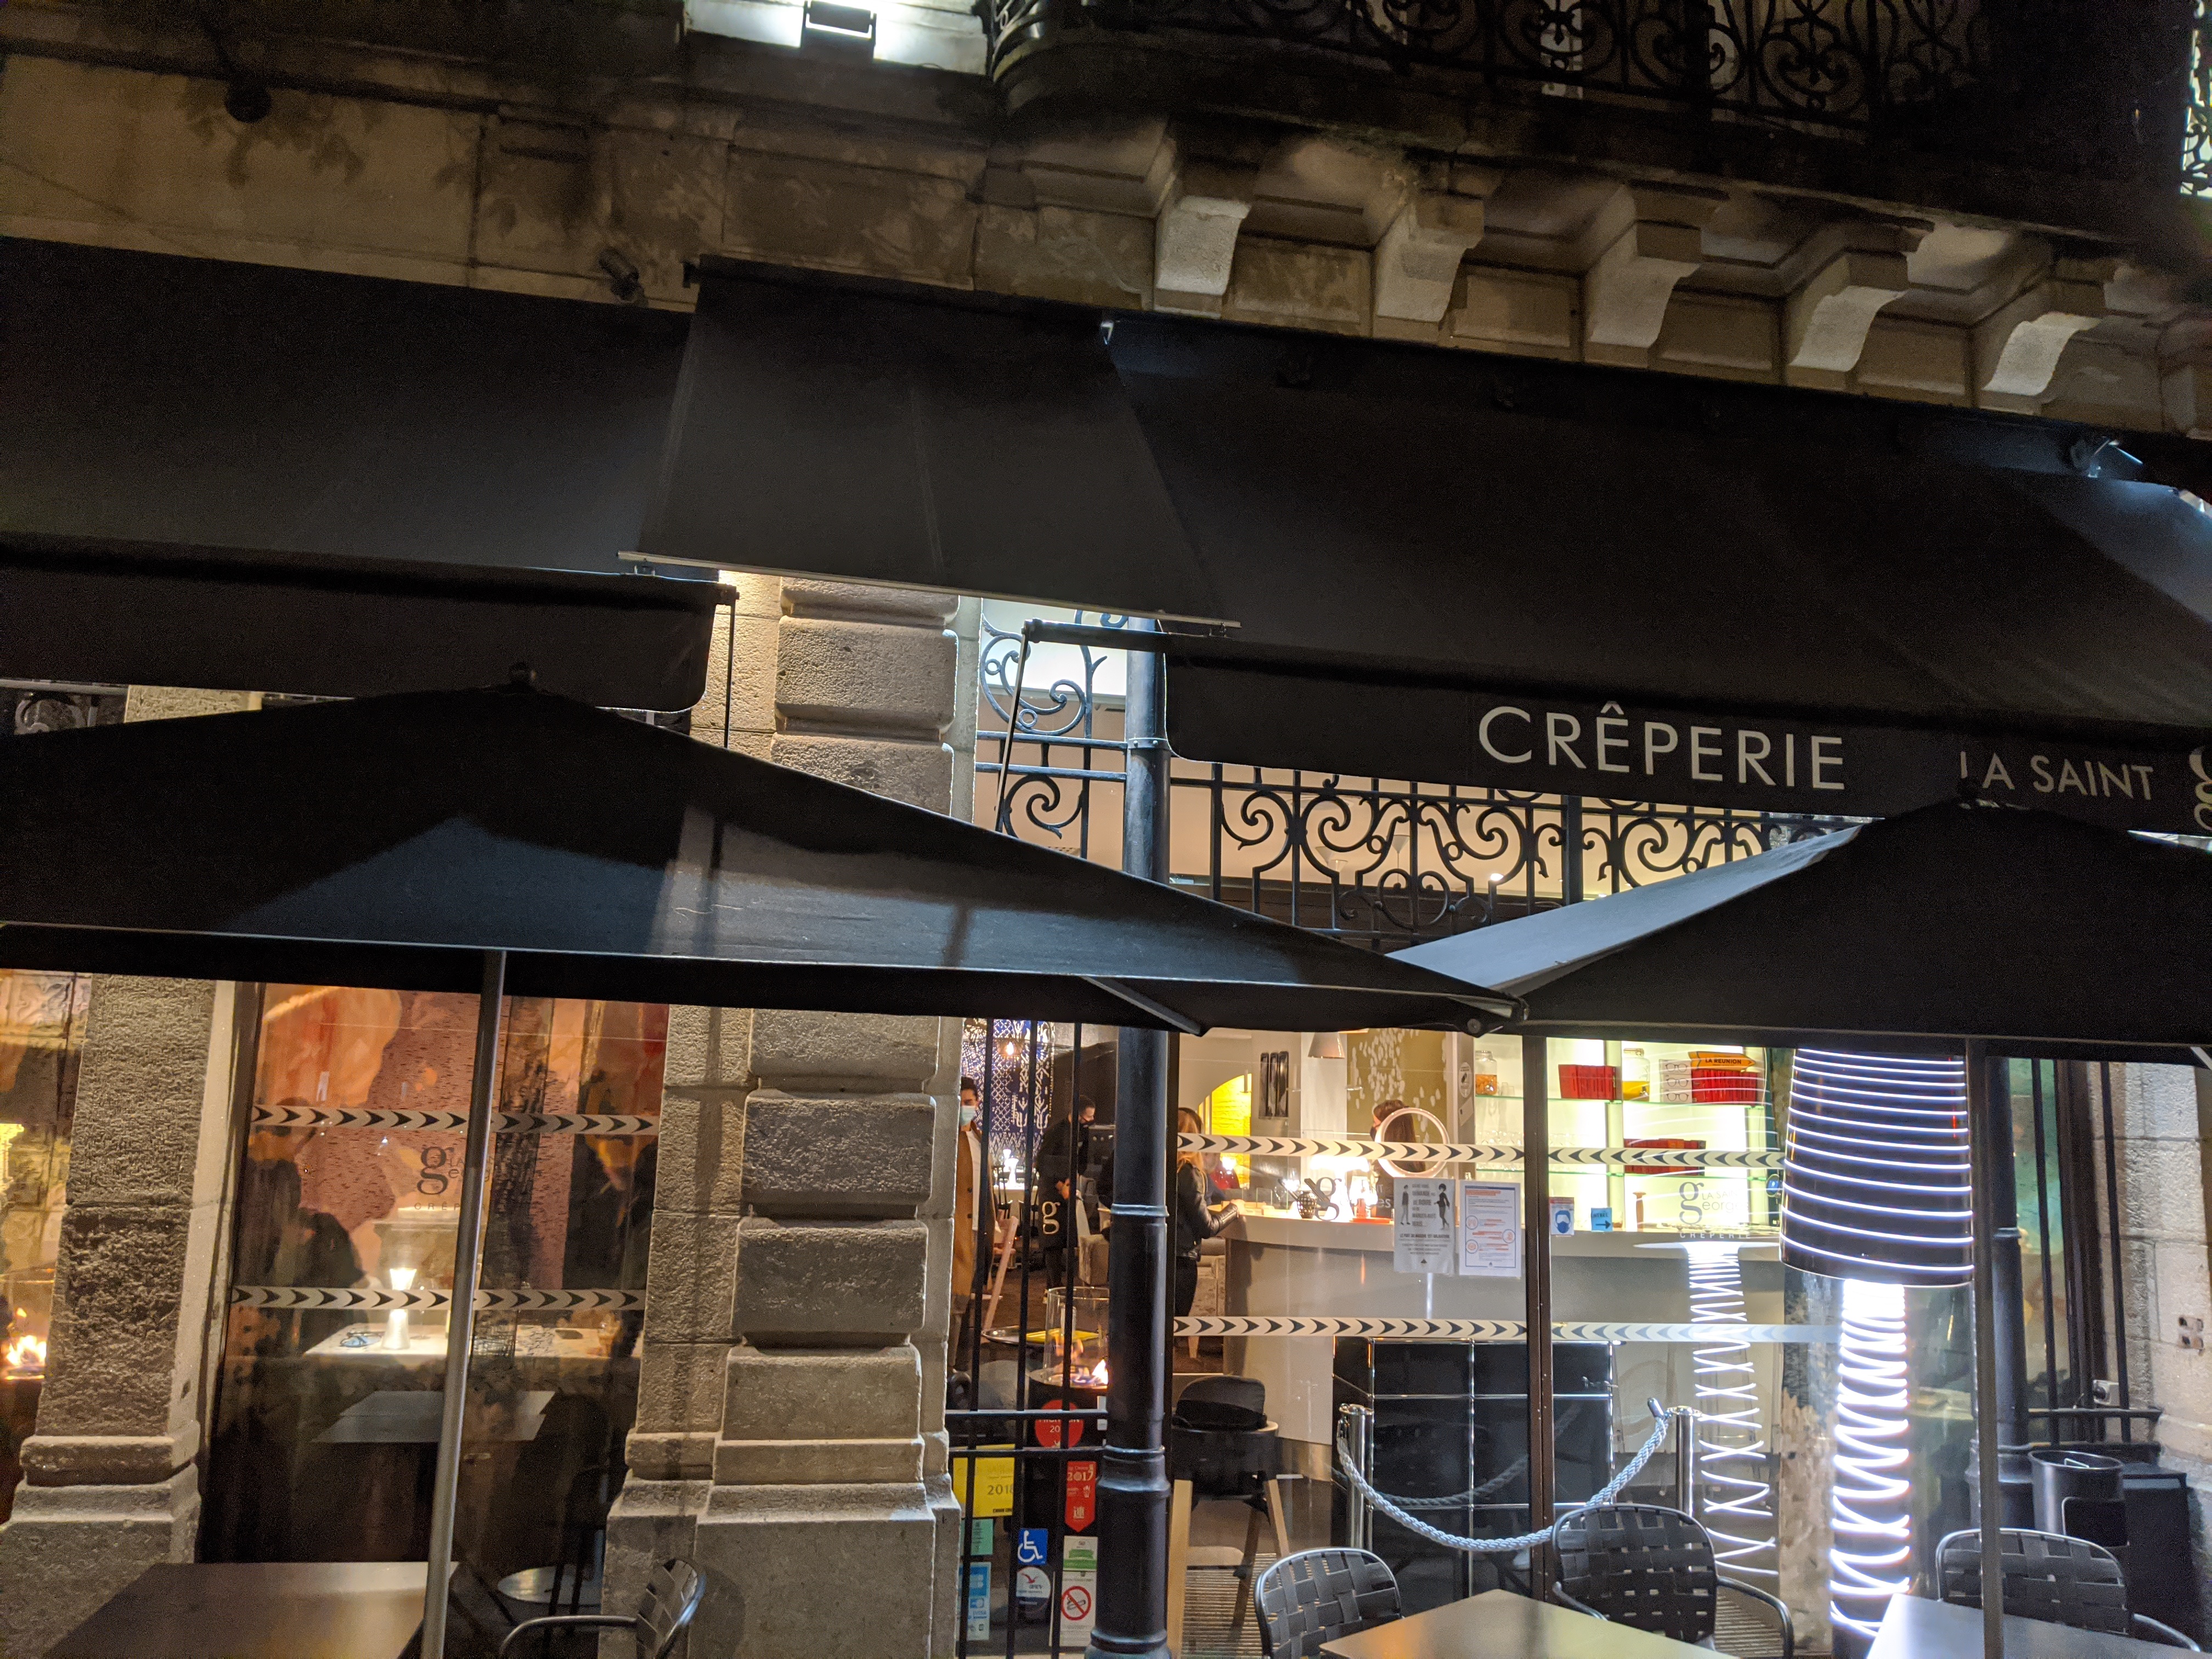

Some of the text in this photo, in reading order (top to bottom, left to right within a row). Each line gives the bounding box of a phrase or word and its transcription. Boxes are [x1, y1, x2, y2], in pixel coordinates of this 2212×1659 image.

[1479, 701, 1845, 790] CRÊPERIE
[2030, 755, 2153, 800] SAINT
[1716, 1189, 1741, 1199] SAIN
